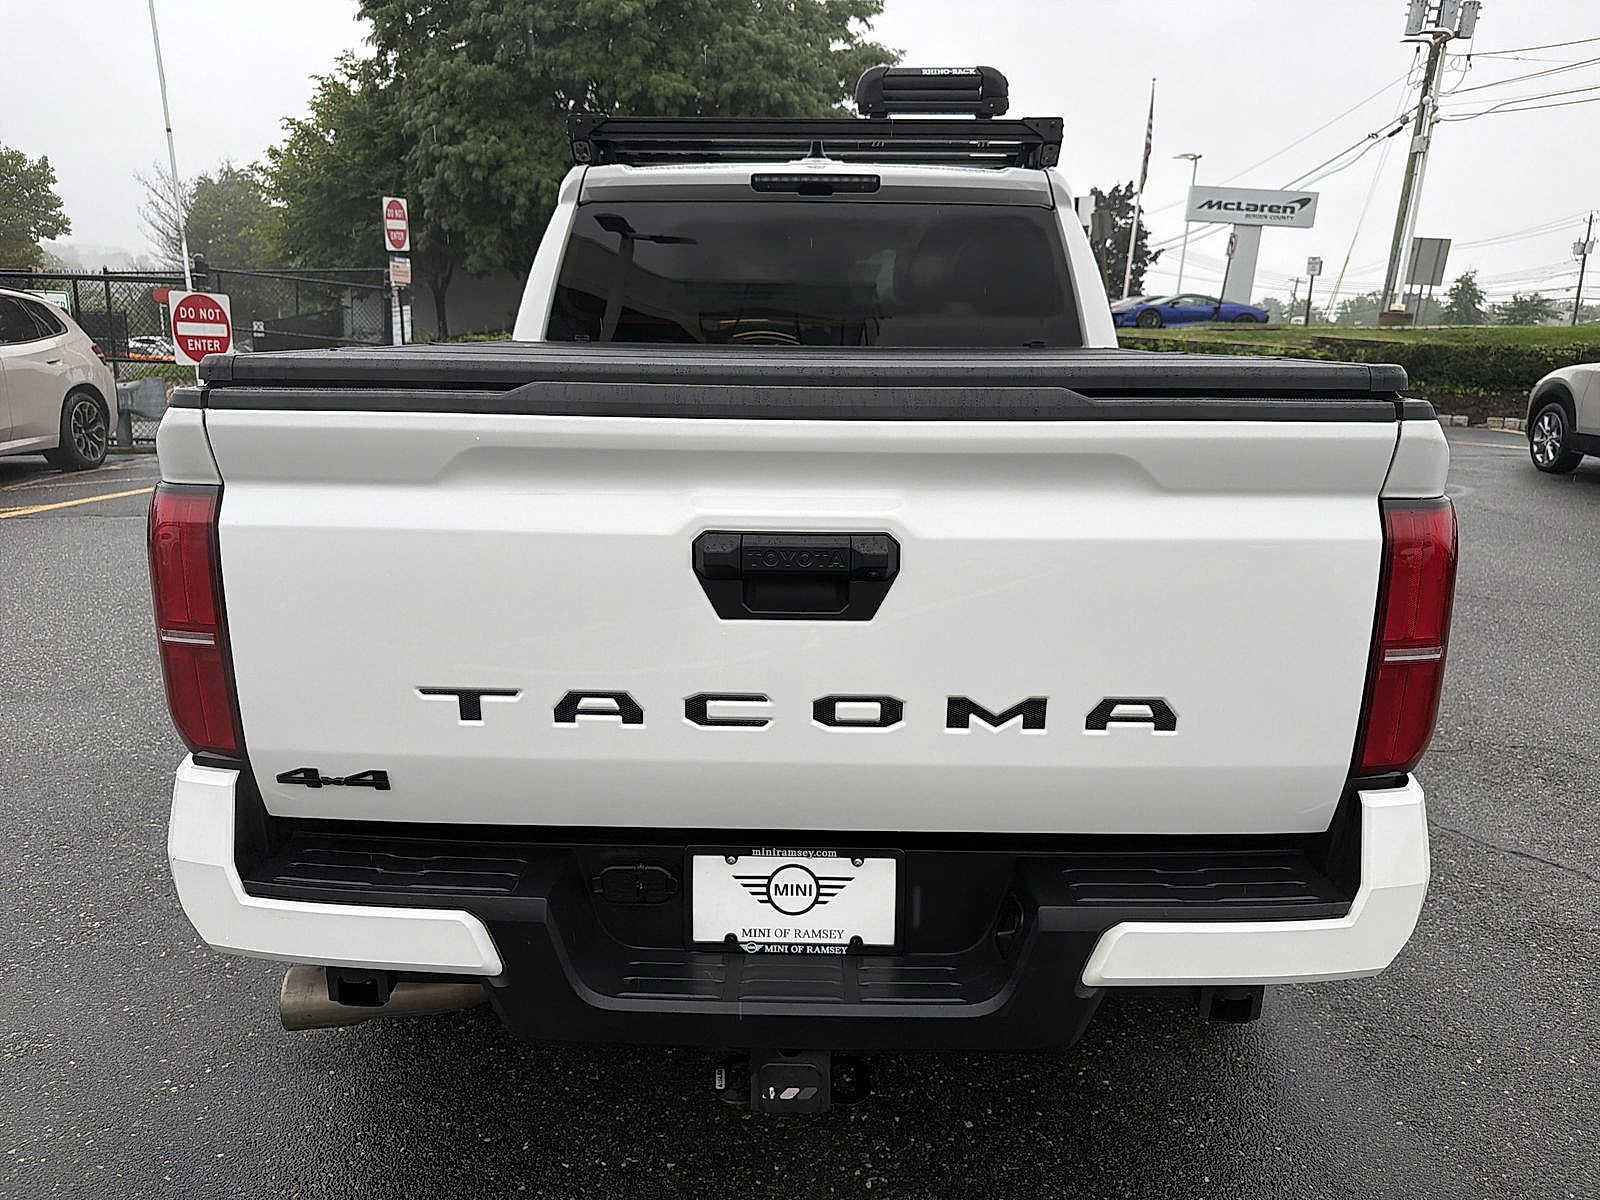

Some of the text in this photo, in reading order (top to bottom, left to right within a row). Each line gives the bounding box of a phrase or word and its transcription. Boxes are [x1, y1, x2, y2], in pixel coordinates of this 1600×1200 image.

[1197, 199, 1296, 214] McLaren
[180, 306, 220, 320] DO NOT
[187, 338, 221, 352] ENTER
[743, 550, 847, 568] TOYOTA
[416, 686, 1178, 733] TACOMA
[752, 848, 838, 859] miniramsey.com
[773, 883, 814, 897] MINI
[741, 928, 845, 939] MINI OF RAMSEY
[764, 944, 791, 953] MINI
[791, 945, 805, 954] OF
[806, 945, 849, 955] RAMSEY
